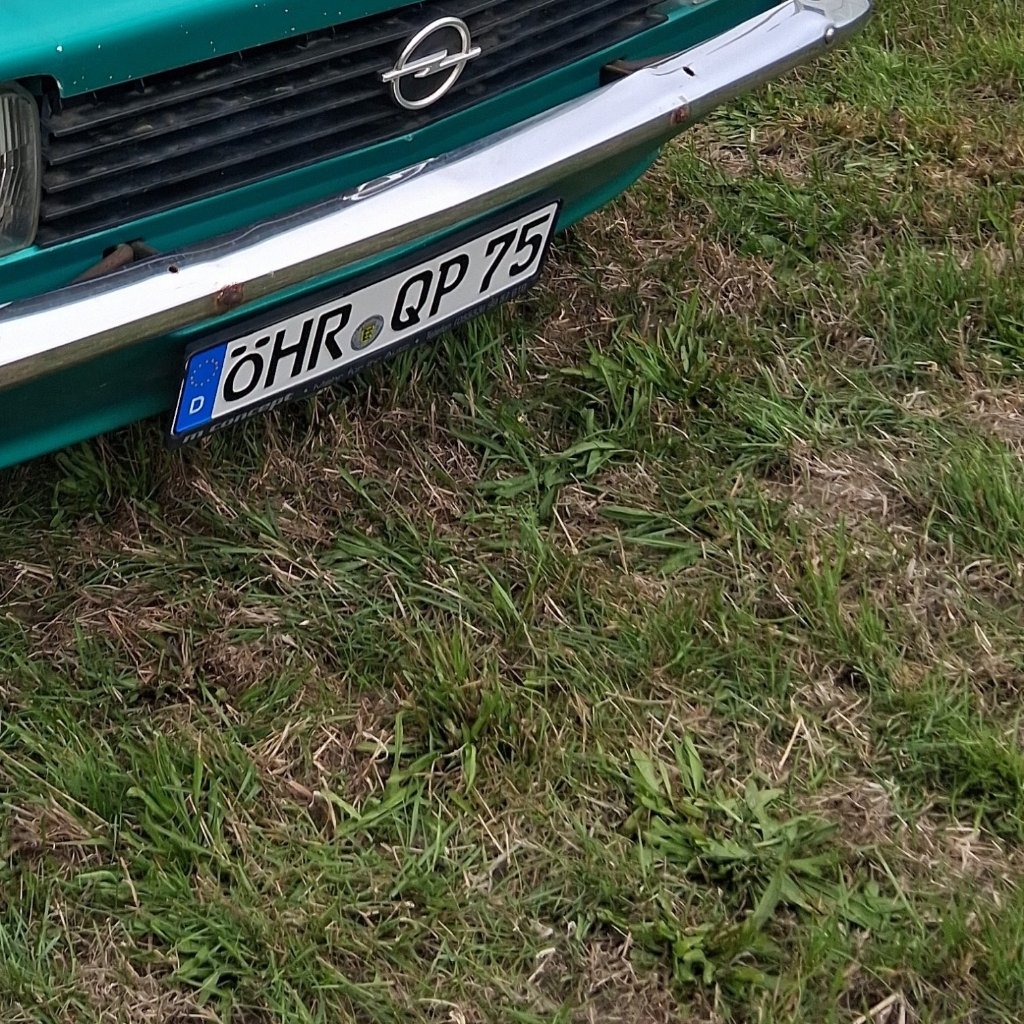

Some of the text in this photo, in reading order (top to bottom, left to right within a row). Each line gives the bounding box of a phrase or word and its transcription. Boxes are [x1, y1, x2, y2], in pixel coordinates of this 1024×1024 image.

[222, 302, 353, 402] ÖHR
[390, 253, 469, 331] QP
[478, 213, 550, 294] 75
[189, 395, 205, 415] D
[209, 391, 294, 432] concept
